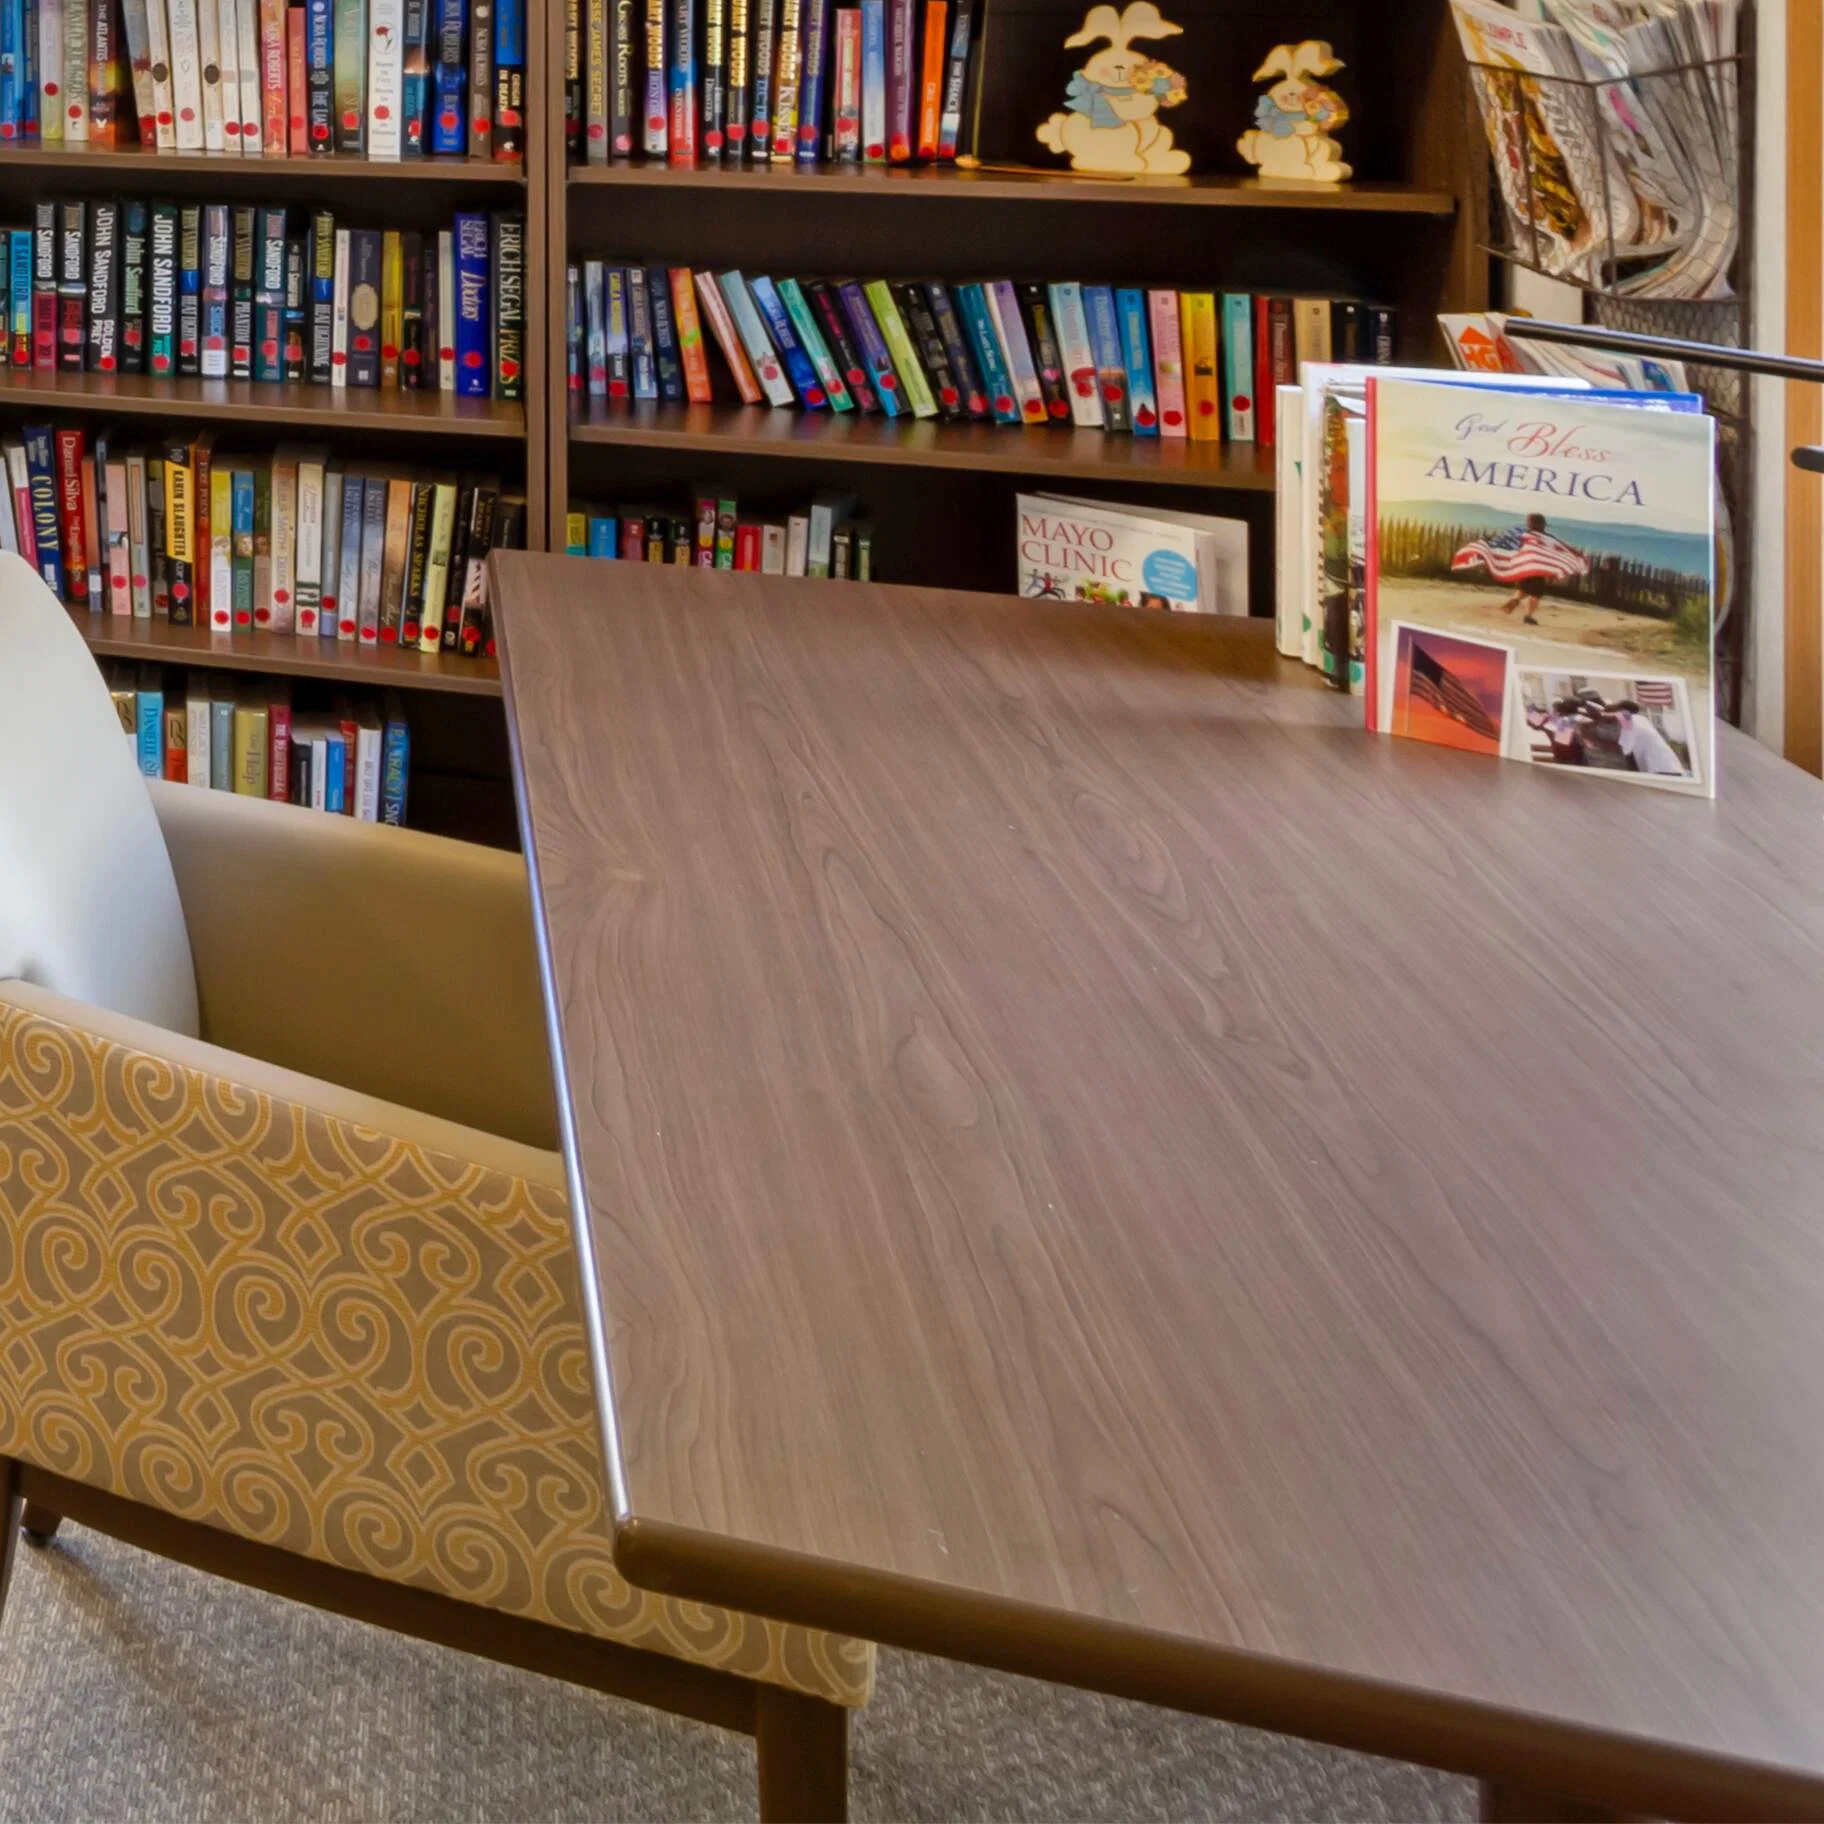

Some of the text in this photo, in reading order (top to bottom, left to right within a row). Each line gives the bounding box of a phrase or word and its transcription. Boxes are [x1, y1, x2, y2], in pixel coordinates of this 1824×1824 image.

[96, 20, 108, 61] ATLANTIS
[563, 30, 579, 80] WOODS
[648, 25, 664, 69] WOODS
[706, 26, 722, 66] WOODS
[730, 36, 746, 88] WOODS
[782, 30, 799, 80] WOODS
[498, 70, 508, 112] IN DEATH
[590, 70, 602, 116] SECRET
[36, 230, 54, 278] SANDFORD
[64, 230, 82, 280] SANDFORD
[91, 208, 114, 314] JOHN SANDFORD
[125, 236, 146, 314] John Sandford
[152, 214, 174, 334] JOHN SANDFORD
[208, 236, 226, 286] SANDFORD
[265, 240, 283, 290] SANDFORD
[499, 223, 522, 326] ERICH SEGAL
[90, 320, 103, 344] PREY
[100, 320, 115, 358] GOLDEN
[234, 301, 251, 343] PHANTOM
[1455, 412, 1613, 466] God Bless
[62, 436, 81, 512] Daniel Silva
[1424, 454, 1647, 508] AMERICA
[32, 475, 59, 552] COLONY
[172, 470, 186, 556] KARIN SLAUGHTER
[1022, 513, 1114, 552] MAYO
[1022, 539, 1132, 582] CLINIC
[242, 750, 263, 785] Help
